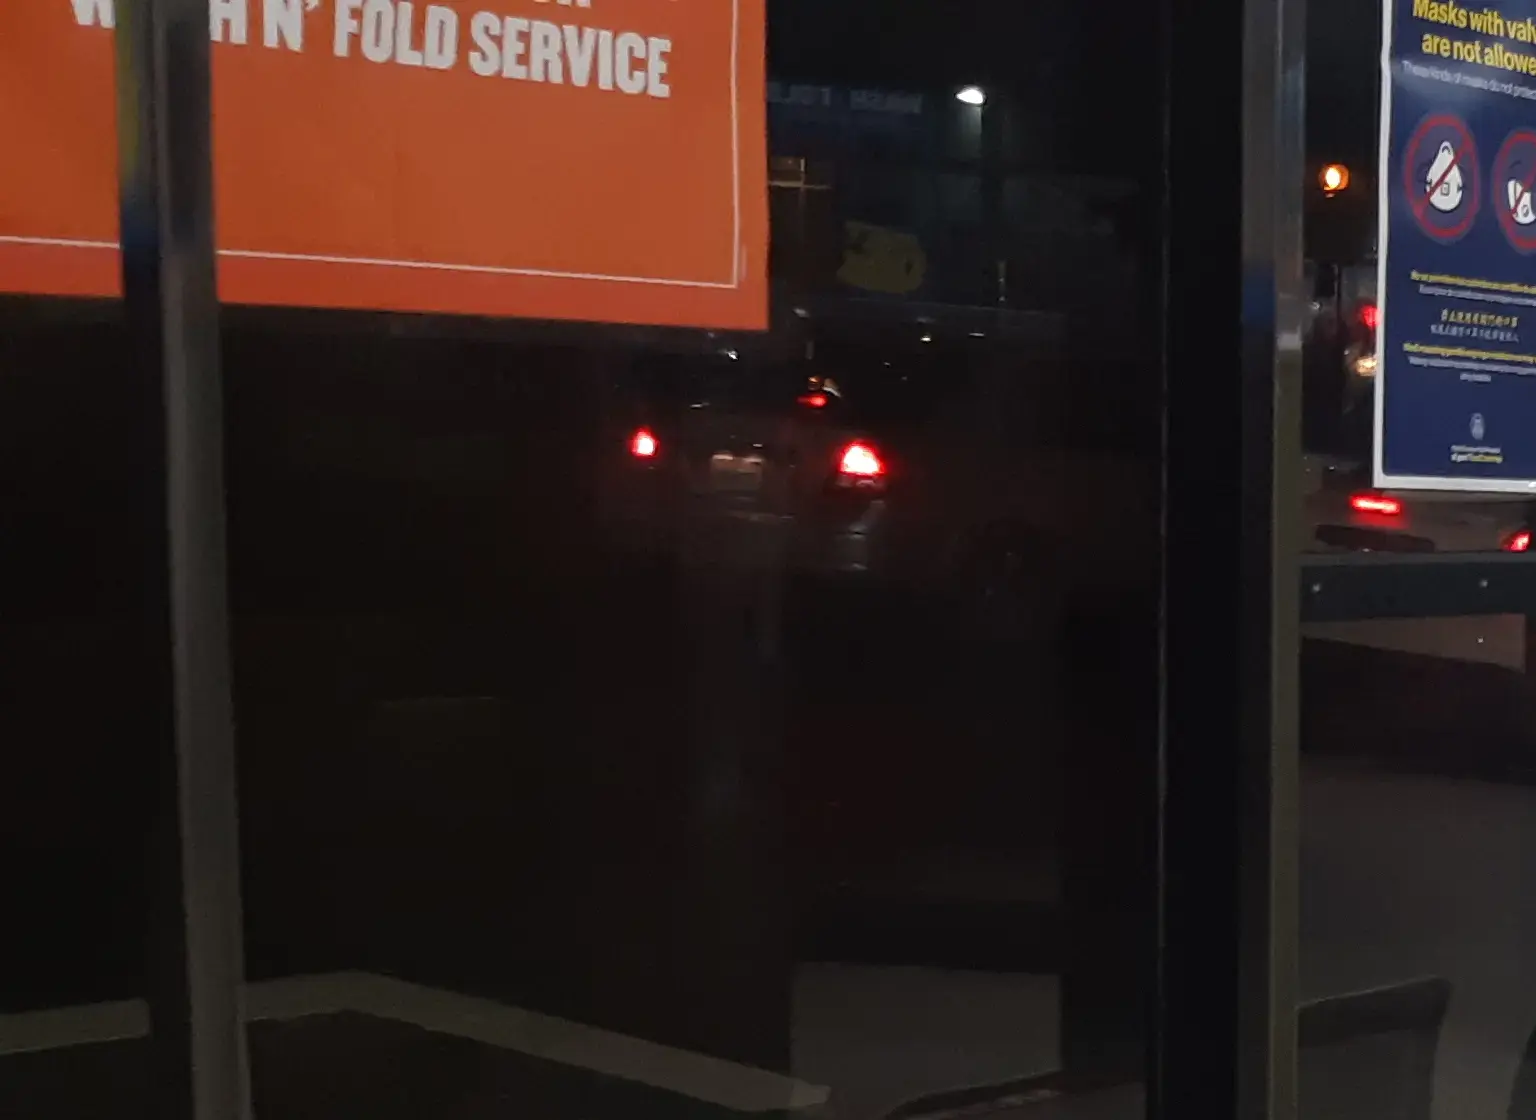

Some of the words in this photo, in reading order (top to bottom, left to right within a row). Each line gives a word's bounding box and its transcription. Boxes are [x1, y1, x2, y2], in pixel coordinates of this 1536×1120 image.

[1413, 0, 1467, 29] Masks
[1468, 8, 1504, 38] with
[333, 2, 459, 70] FOLD
[469, 14, 672, 98] SERVICE
[1421, 33, 1451, 58] are
[1453, 41, 1482, 64] not
